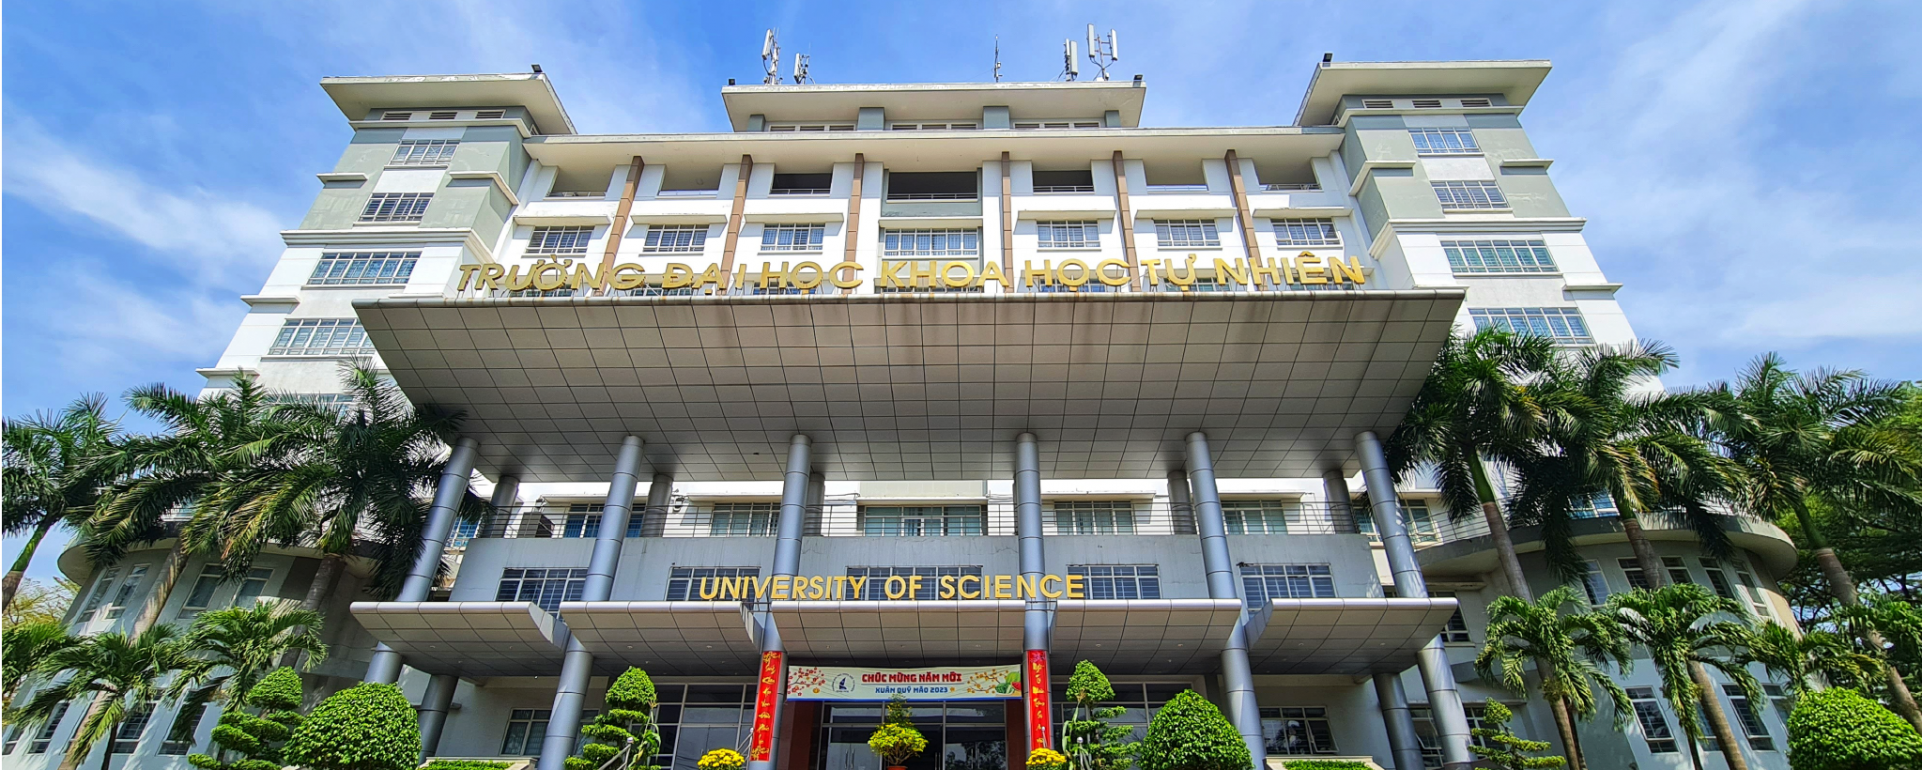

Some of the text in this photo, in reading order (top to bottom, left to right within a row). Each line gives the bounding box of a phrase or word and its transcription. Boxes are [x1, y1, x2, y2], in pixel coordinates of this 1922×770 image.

[457, 251, 1366, 295] TRƯỜNG ĐẠI HỌC KHOA HỌC TỰ NHIÊN
[699, 574, 1085, 600] UNIVERSITY OF SCIENCE
[862, 672, 887, 683] CHÚC
[889, 672, 917, 682] MỪNG
[919, 672, 940, 682] NĂM
[942, 671, 962, 682] MỚI
[875, 685, 896, 693] XUÂN
